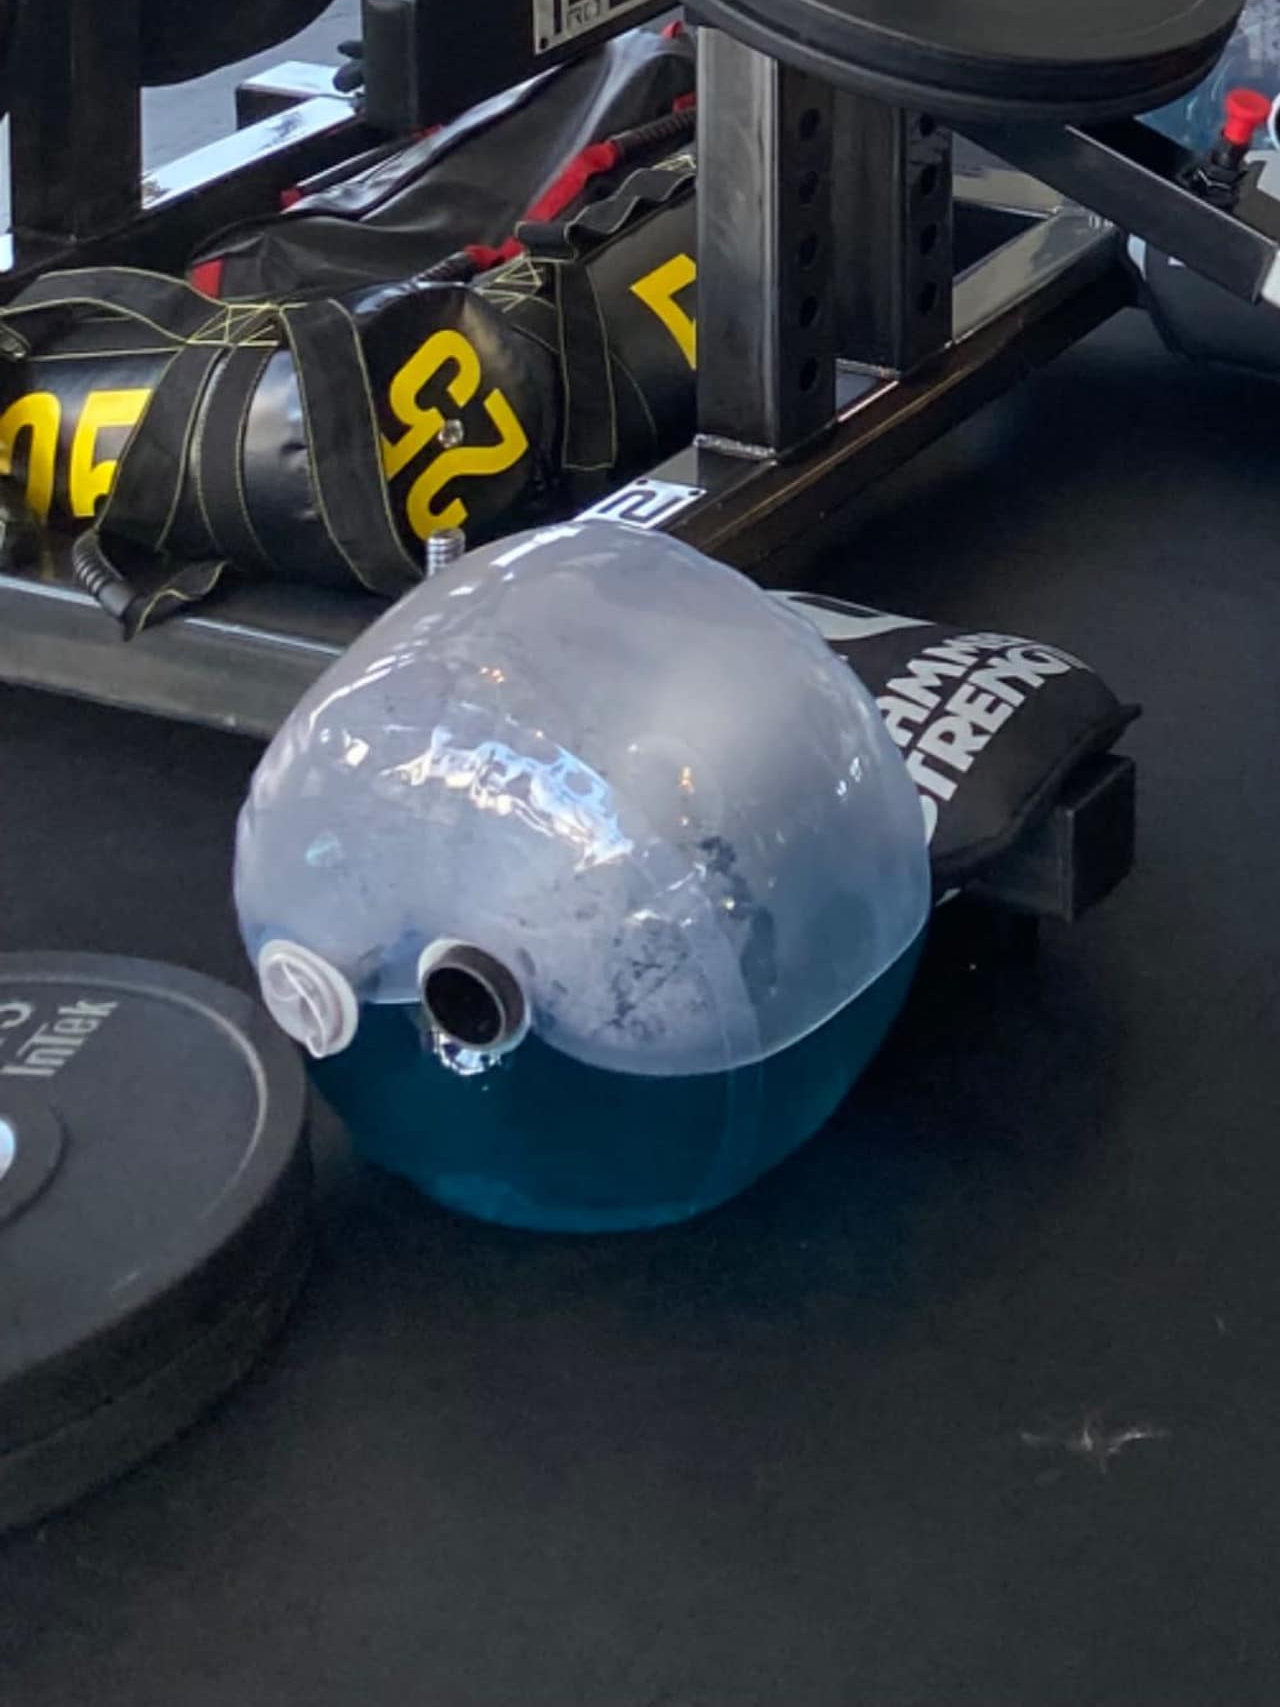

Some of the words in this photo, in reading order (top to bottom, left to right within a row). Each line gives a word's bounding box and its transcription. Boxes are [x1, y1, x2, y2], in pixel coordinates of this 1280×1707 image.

[875, 632, 1038, 748] AMM
[905, 644, 1096, 845] TRENG
[2, 998, 119, 1078] InTek
